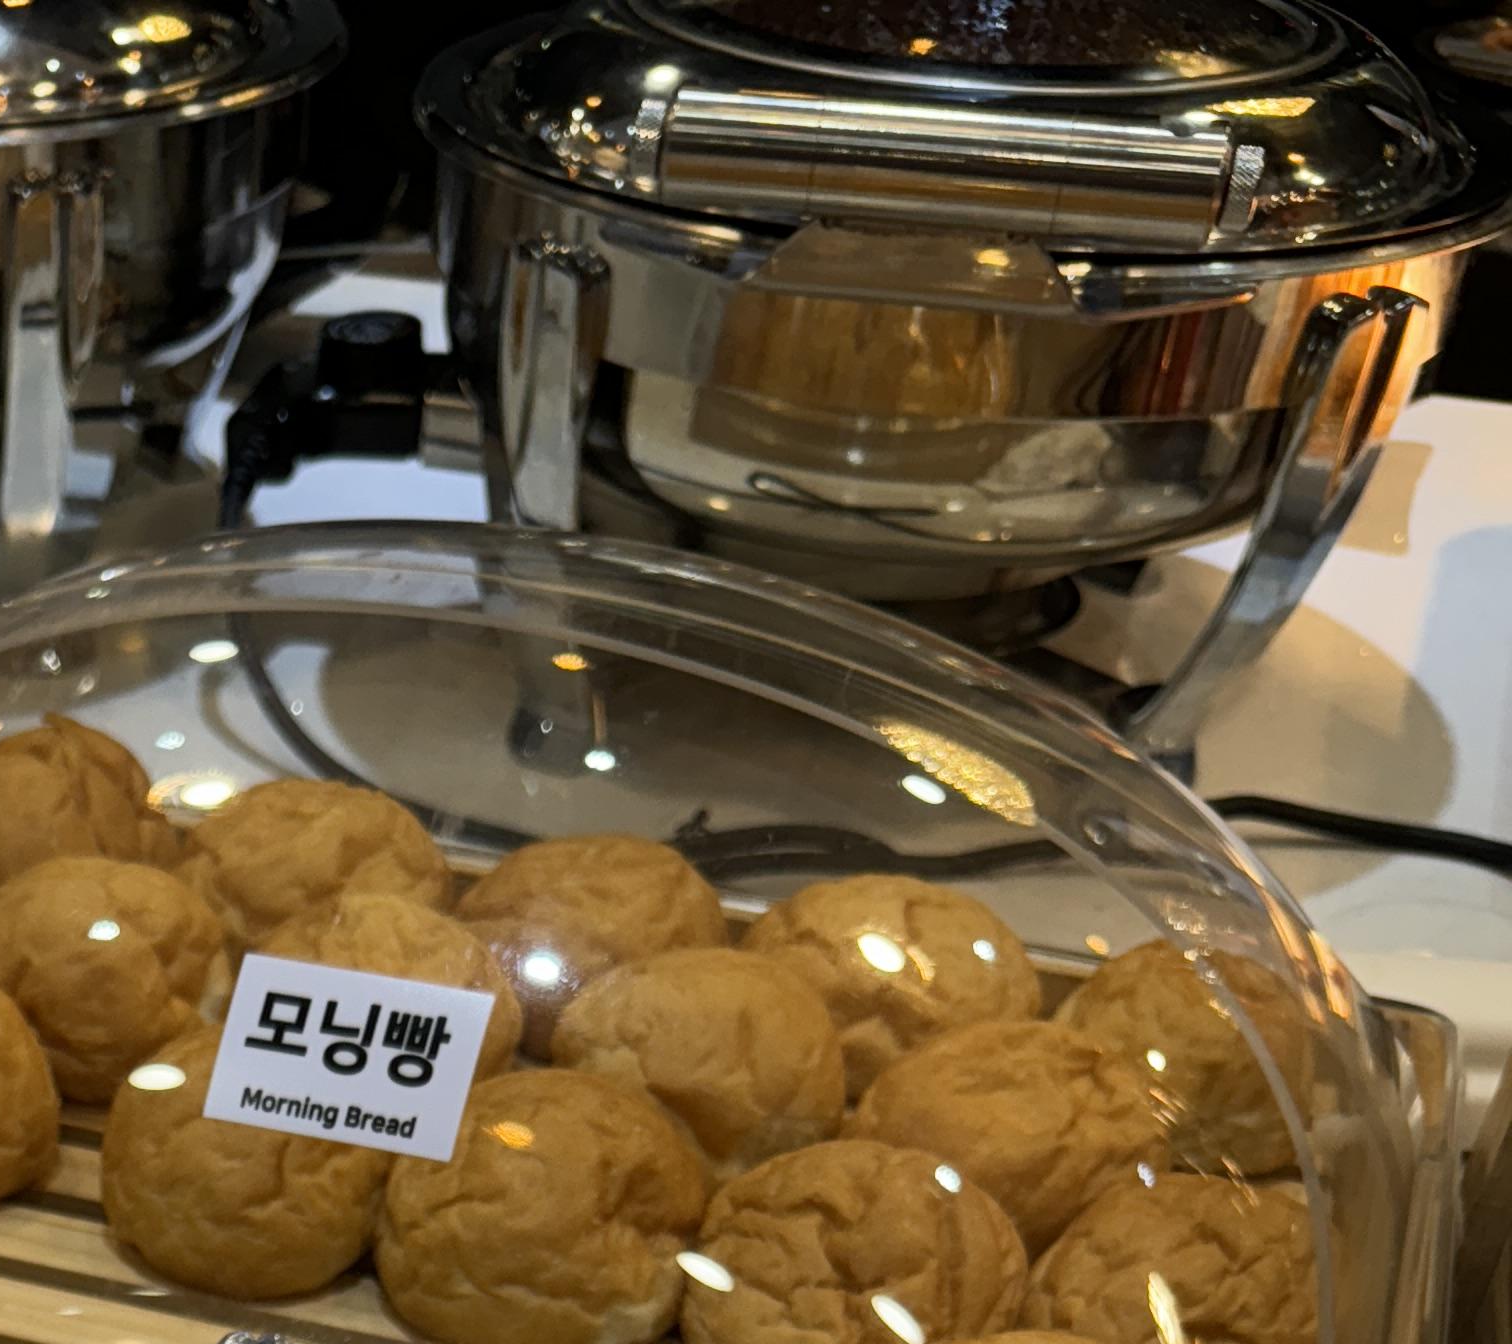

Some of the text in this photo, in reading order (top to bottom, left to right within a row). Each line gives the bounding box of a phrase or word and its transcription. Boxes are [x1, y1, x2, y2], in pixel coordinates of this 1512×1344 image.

[244, 991, 451, 1088] 모닝빵
[240, 1087, 418, 1139] Morning Bread
